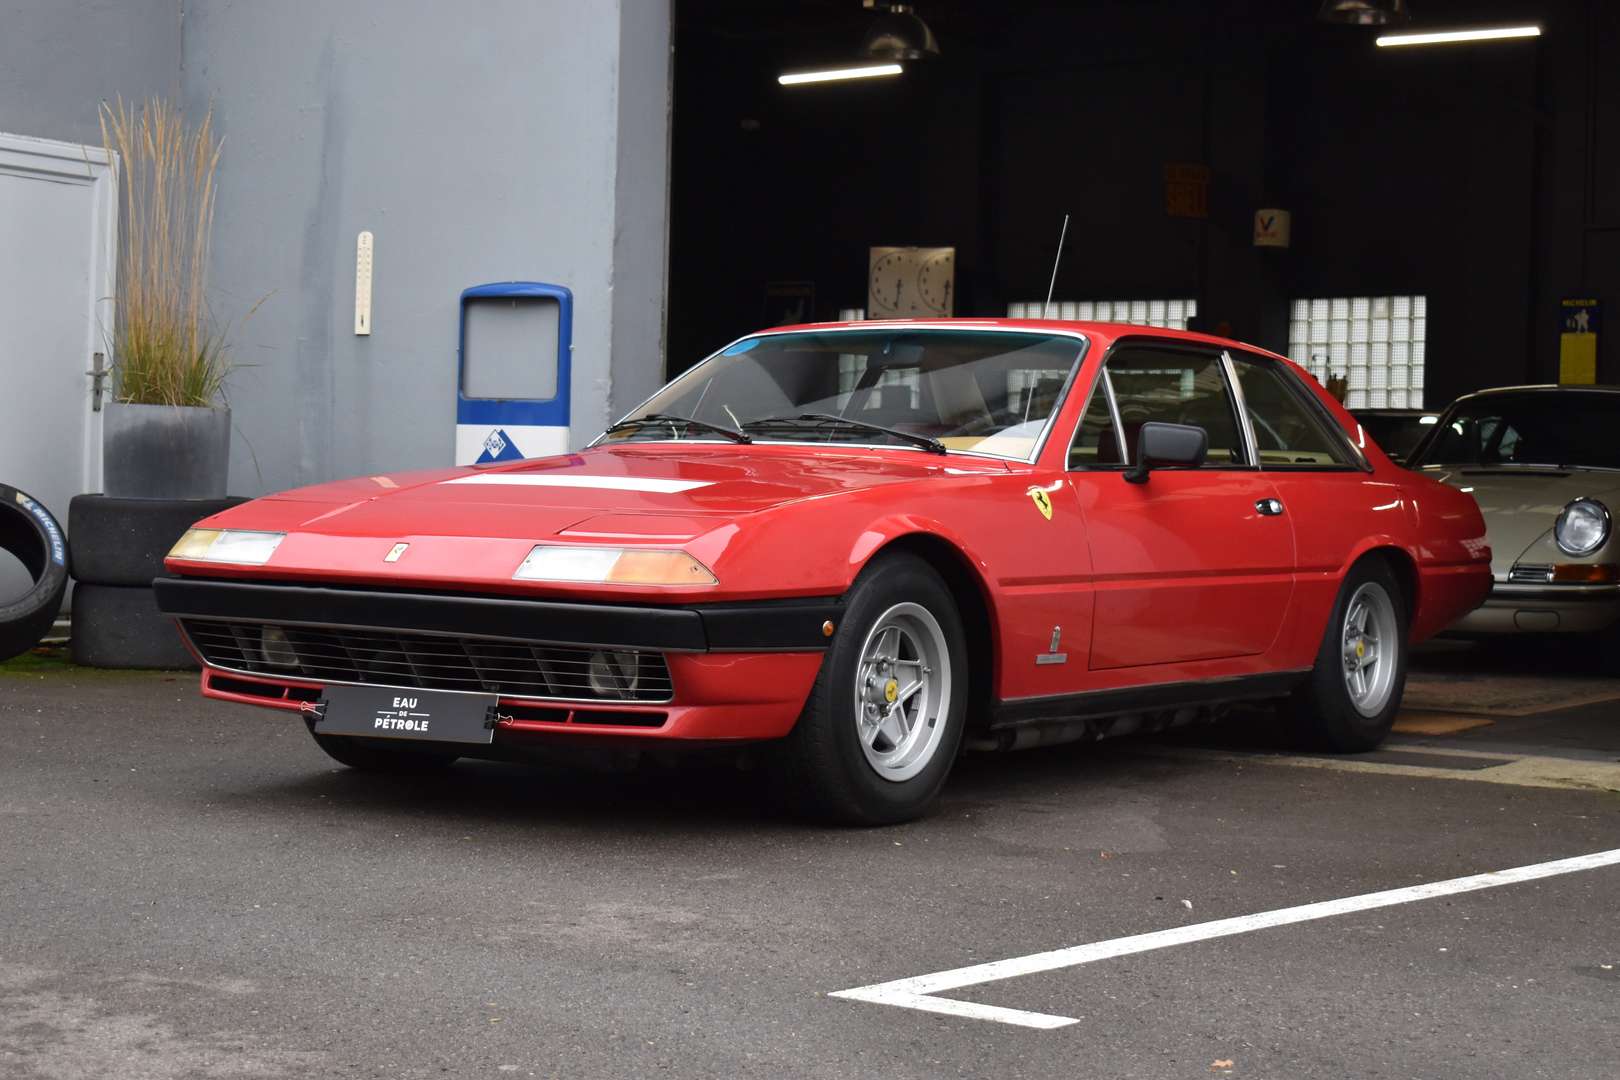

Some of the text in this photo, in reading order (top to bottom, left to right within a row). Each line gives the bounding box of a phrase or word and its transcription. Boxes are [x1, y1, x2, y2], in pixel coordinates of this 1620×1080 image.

[33, 507, 63, 560] MICHELIN
[393, 697, 418, 709] EAU
[374, 715, 429, 732] PÉTROLE
